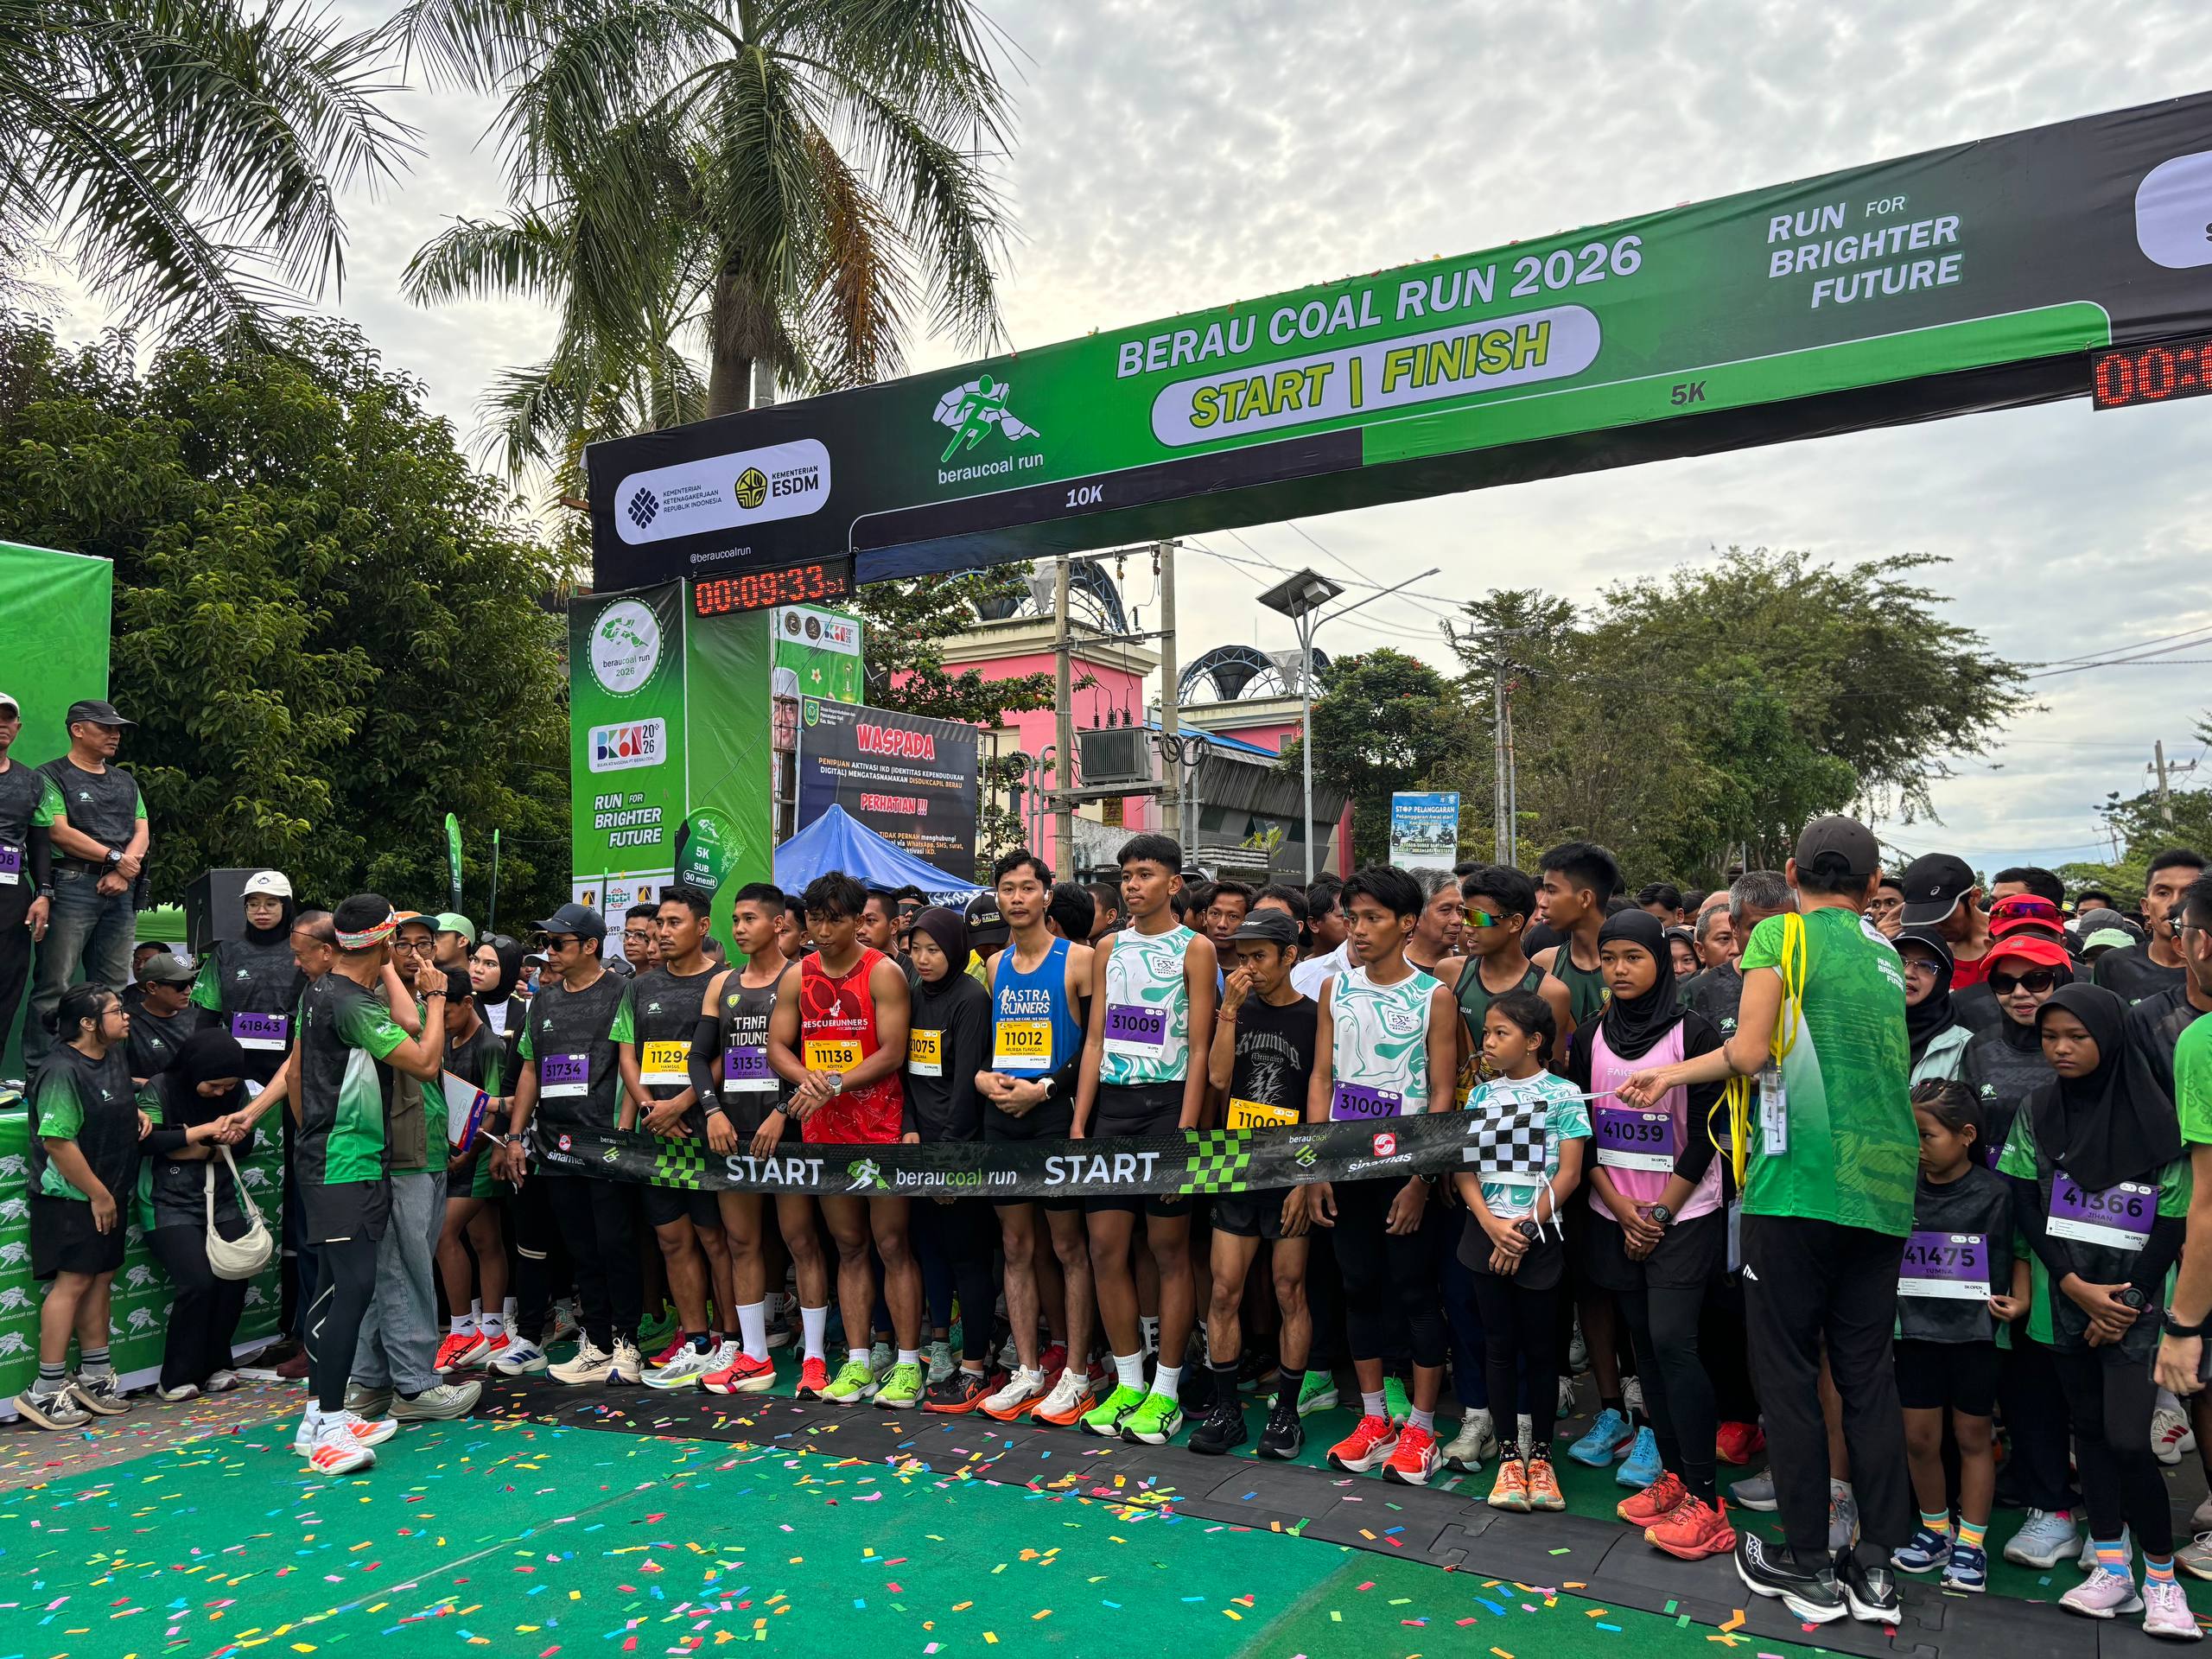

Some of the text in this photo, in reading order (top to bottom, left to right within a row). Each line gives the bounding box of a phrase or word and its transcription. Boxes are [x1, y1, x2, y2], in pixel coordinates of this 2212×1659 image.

[1766, 194, 1906, 245] RUN FOR
[1768, 215, 1961, 278] BRIGHTER
[1810, 254, 1964, 309] FUTURE
[1116, 234, 1644, 379] BERAU COAL RUN 2026
[1189, 362, 1334, 429] START
[1379, 319, 1553, 395] FINISH
[2095, 340, 2212, 405] 00:
[1669, 379, 1708, 406] 5K
[772, 465, 818, 480] KEMENTERIAN
[938, 453, 1044, 485] beraucoal run
[663, 485, 702, 498] KEMENTERIAN
[772, 474, 818, 498] ESDM
[663, 490, 719, 505] KETENAGAKERJAAN
[663, 497, 722, 513] REPUBLIK INDONESIA
[1065, 484, 1103, 508] 10K
[690, 545, 751, 563] @beraucoalrun
[696, 565, 823, 614] 00:09:33
[602, 654, 651, 668] beraucoal run
[615, 667, 635, 677] 2026
[856, 724, 935, 760] WASPADA
[818, 757, 850, 768] PENIPUAN
[851, 761, 879, 772] AKTIVASI
[891, 767, 921, 777] (IDENTITAS
[922, 771, 964, 781] KEPENDUDUKAN
[820, 766, 848, 777] DIGITAL)
[849, 770, 908, 783] MENGATASNAMAKAN
[909, 777, 945, 787] DISDUKCAPIL
[594, 792, 644, 810] RUN FOR
[861, 792, 916, 814] PERHATIAN
[594, 808, 662, 830] BRIGHTER
[608, 828, 663, 848] FUTURE
[920, 835, 957, 843] menghubungi
[696, 846, 709, 860] 5K
[694, 862, 709, 874] SUB
[685, 873, 715, 887] 30 menit
[1008, 989, 1051, 1001] ASTRA
[1001, 1002, 1051, 1015] RUNNERS
[239, 1020, 281, 1033] 41843
[734, 1015, 766, 1030] TANA
[802, 1019, 868, 1028] RESCUERUNNERS
[1112, 1014, 1160, 1033] 31009
[730, 1032, 768, 1046] TIDUNG
[910, 1038, 936, 1054] 21075
[1005, 1032, 1043, 1046] 11012
[652, 1050, 690, 1064] 11294
[815, 1050, 853, 1064] 11138
[546, 1063, 582, 1077] 31734
[1340, 1093, 1395, 1117] 31007
[1288, 1133, 1328, 1144] beraucoal
[1603, 1121, 1663, 1143] 41039
[725, 1152, 1160, 1186] START beraucoal run START
[1347, 1152, 1414, 1173] sinarmas
[2063, 1186, 2144, 1217] 41366
[2087, 1211, 2113, 1222] JIHAN
[1904, 1245, 1976, 1268] 41475
